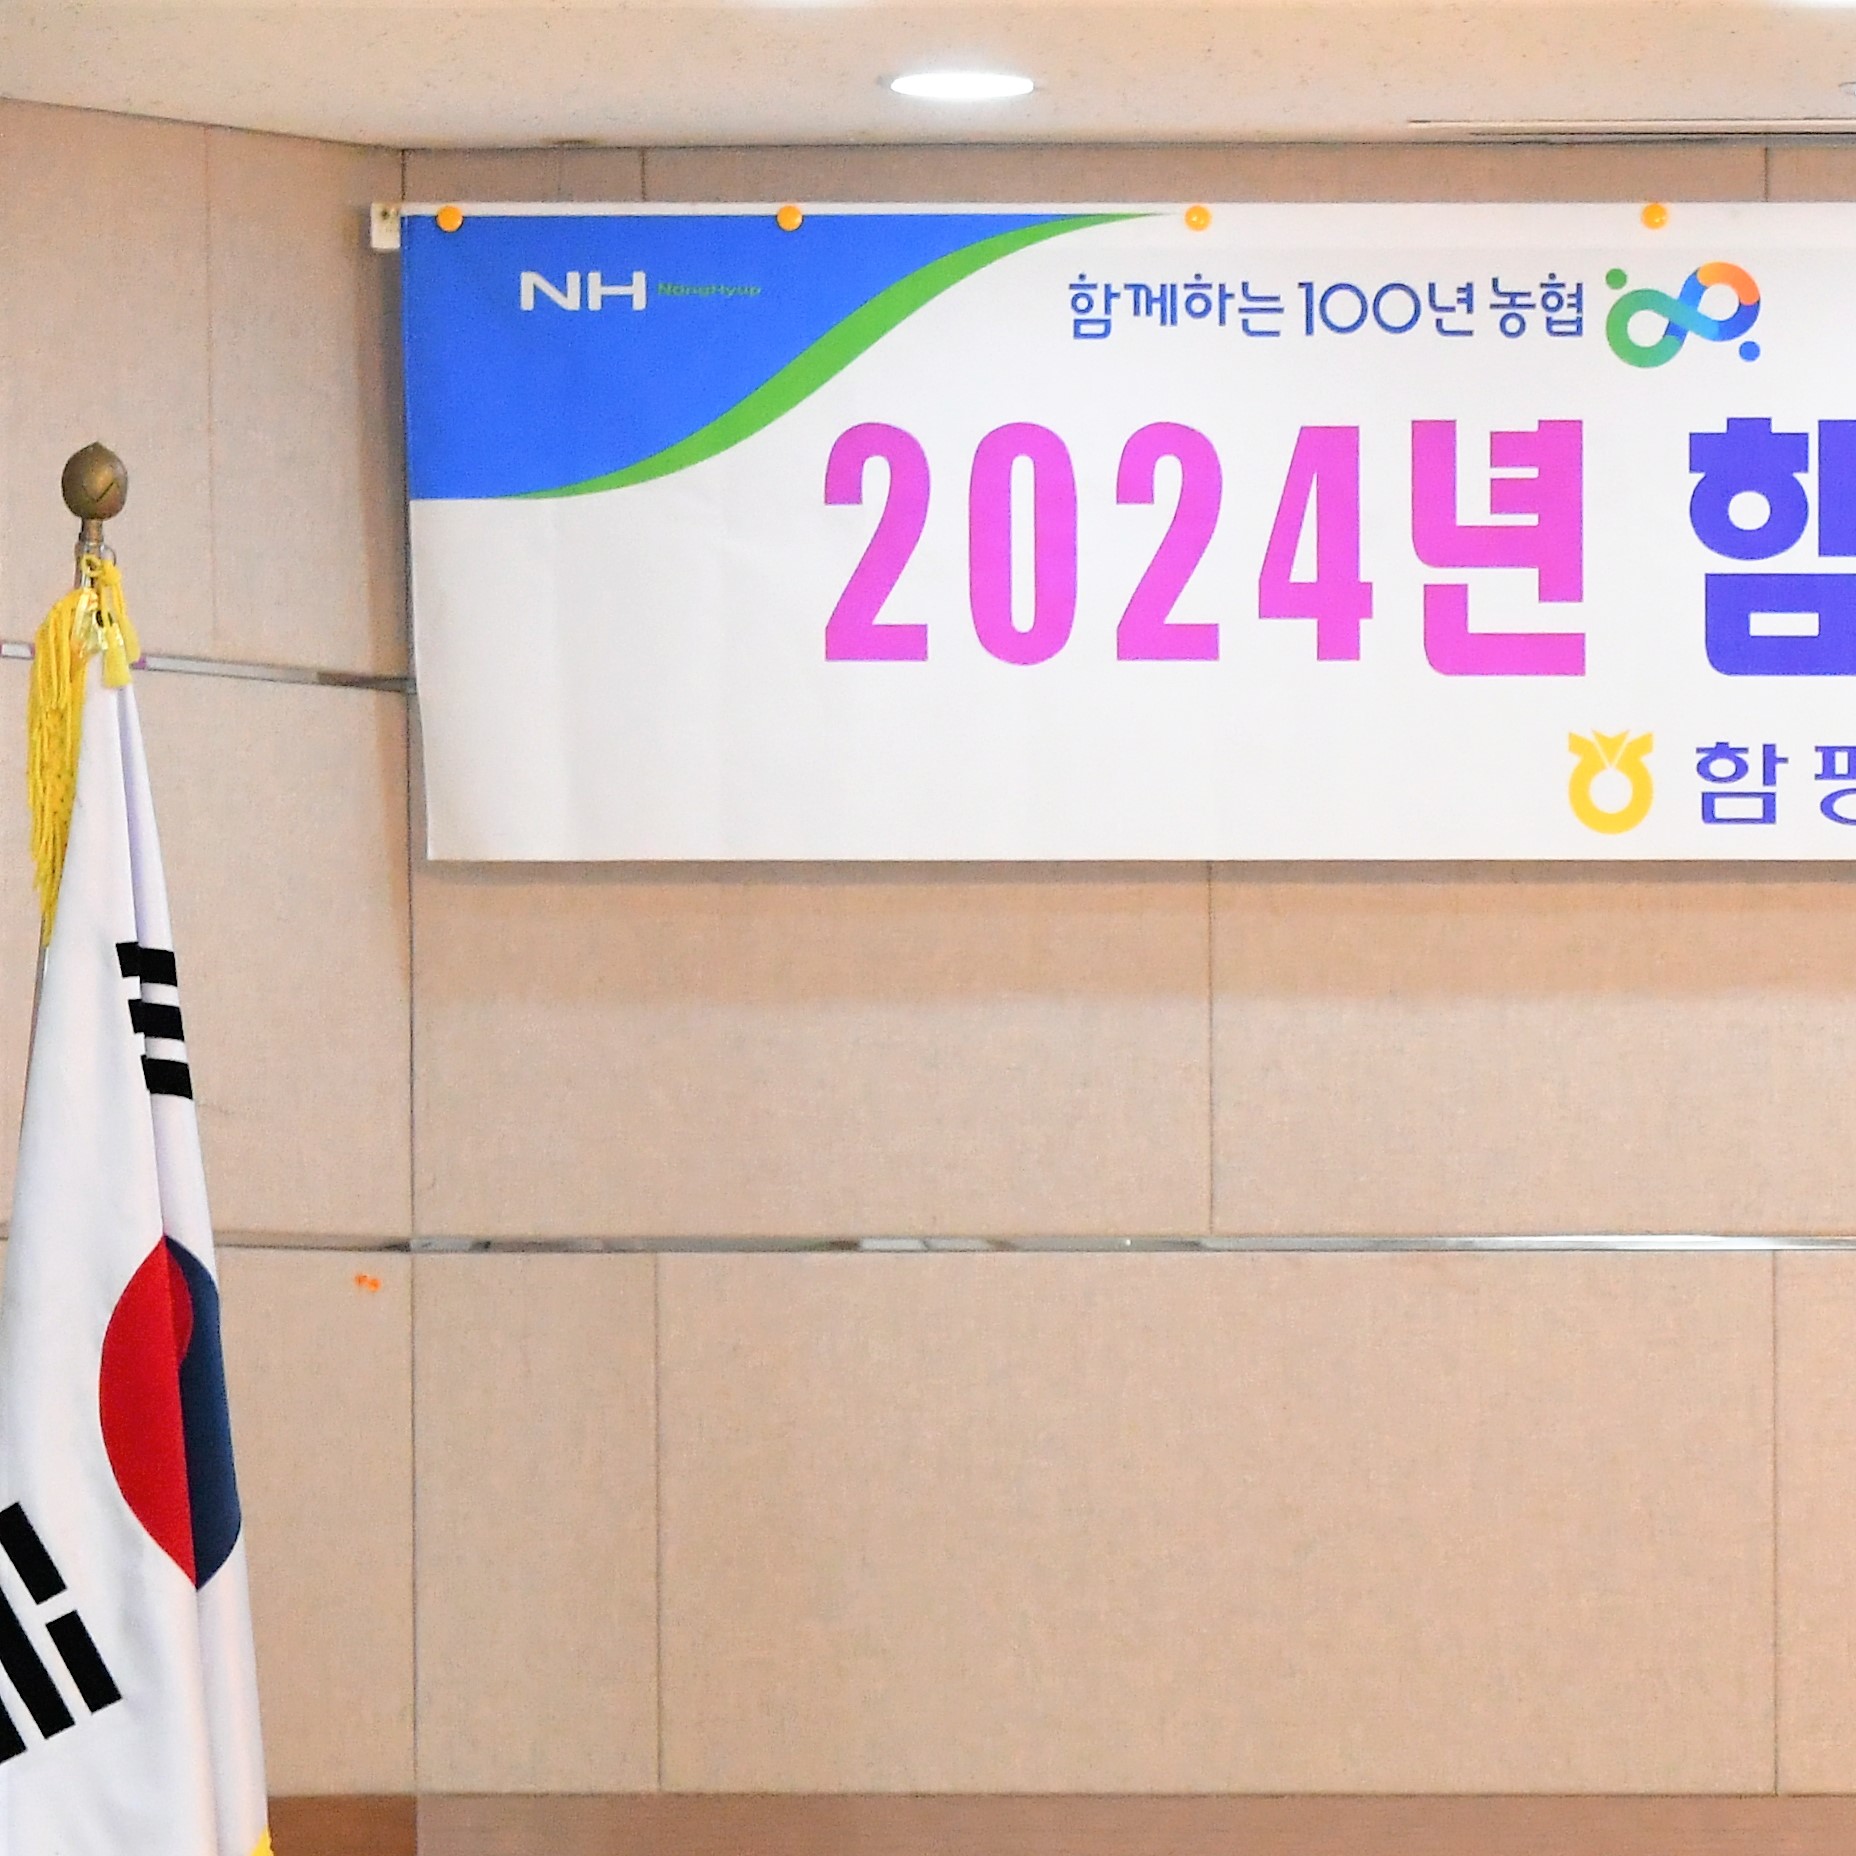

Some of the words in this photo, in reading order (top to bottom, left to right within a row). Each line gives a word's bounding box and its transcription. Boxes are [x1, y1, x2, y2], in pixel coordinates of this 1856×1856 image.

[520, 271, 647, 310] NH
[1069, 273, 1284, 339] 함께하는
[1298, 281, 1474, 337] 100년
[1489, 272, 1583, 338] 농협
[824, 418, 1586, 676] 2024년
